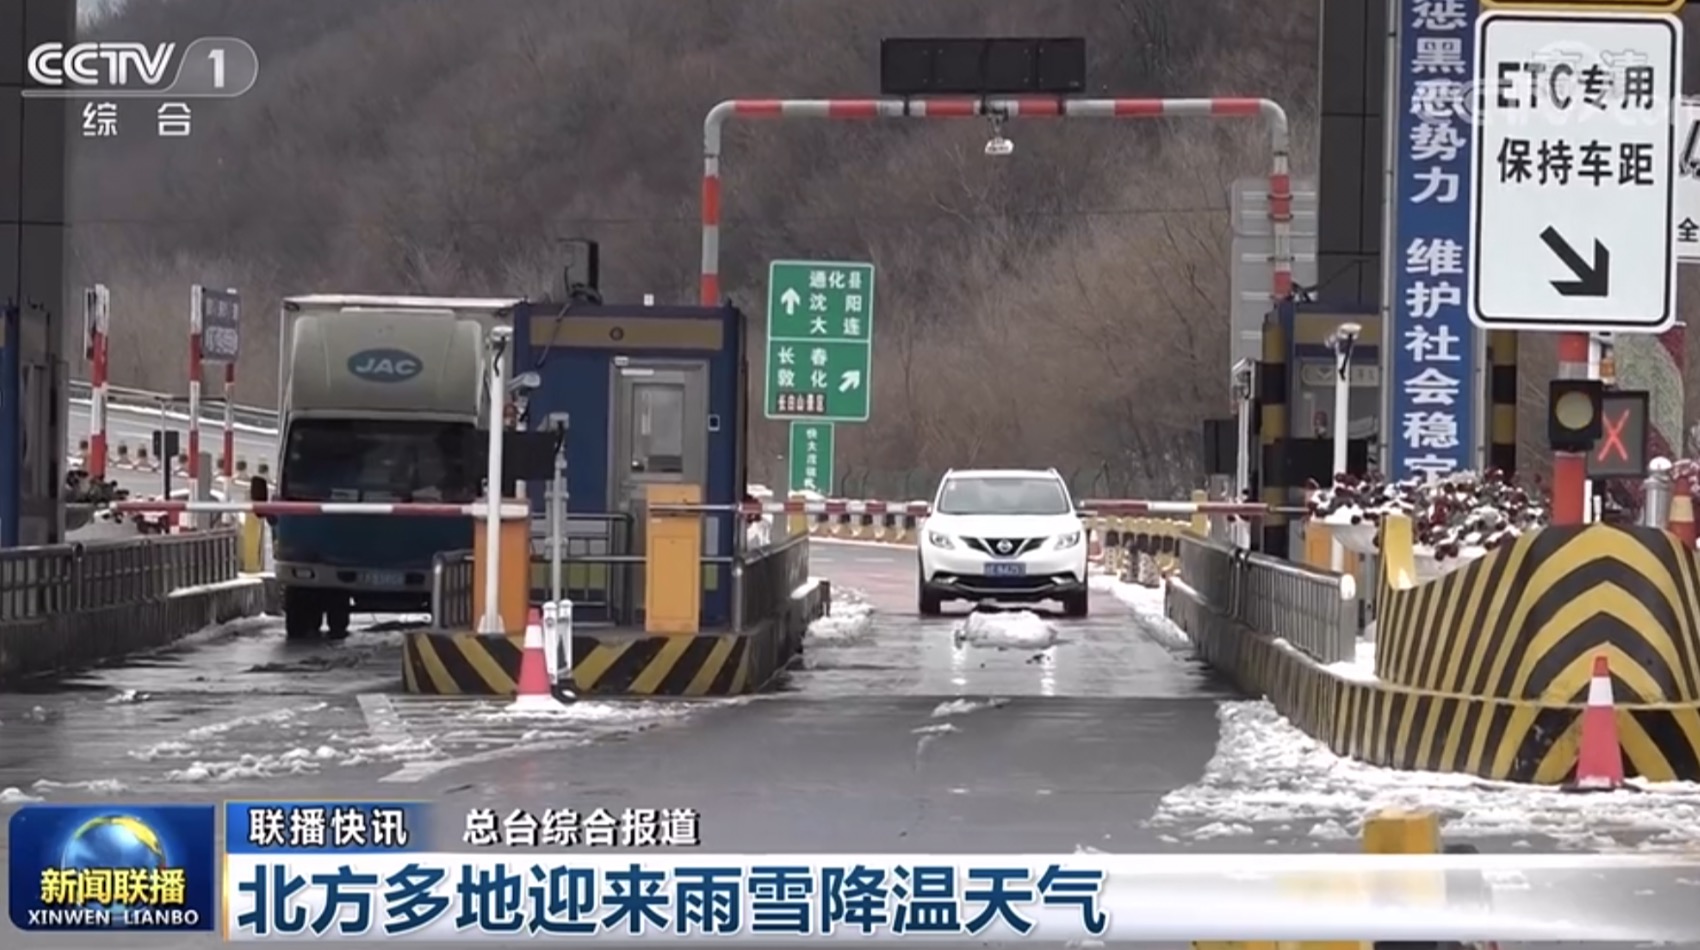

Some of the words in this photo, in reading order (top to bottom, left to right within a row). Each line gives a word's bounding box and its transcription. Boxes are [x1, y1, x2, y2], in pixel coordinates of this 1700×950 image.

[1497, 62, 1655, 110] ETC专用
[1497, 137, 1655, 187] 保持车距
[1677, 217, 1699, 243] 全
[809, 270, 862, 289] 通化县
[809, 294, 862, 313] 沈阳
[809, 317, 861, 336] 大连
[777, 346, 828, 366] 长春
[355, 357, 416, 376] JAC
[777, 369, 828, 388] 敦化
[778, 394, 825, 412] 长白山景区
